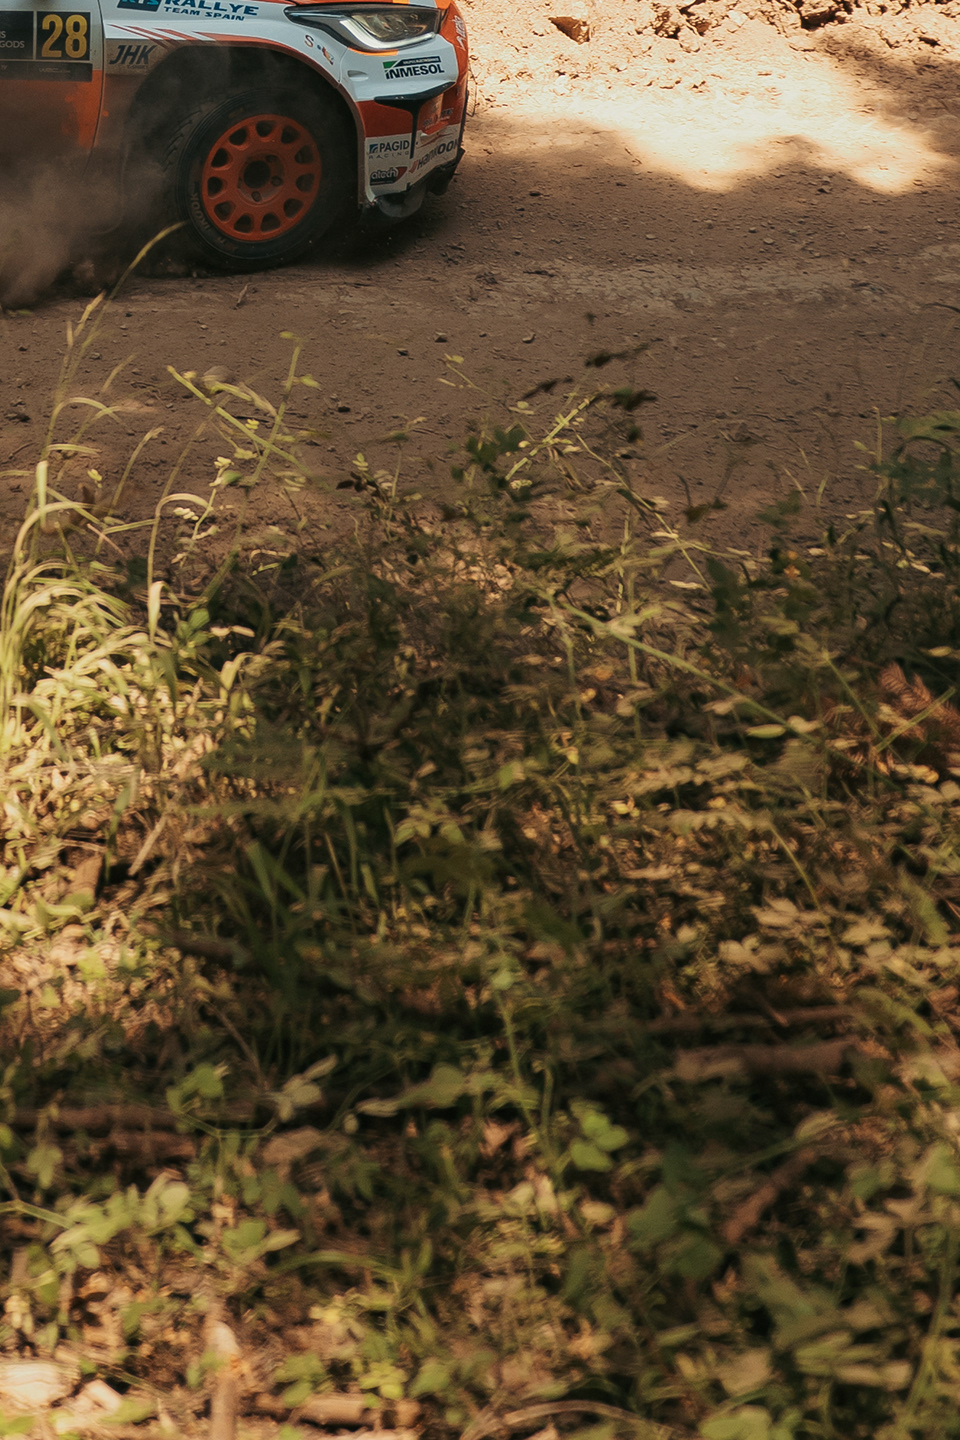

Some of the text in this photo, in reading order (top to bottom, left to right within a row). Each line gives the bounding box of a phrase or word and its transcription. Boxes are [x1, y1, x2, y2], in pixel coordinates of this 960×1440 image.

[164, 6, 245, 21] TEAM SPAIN
[41, 14, 88, 58] 28
[109, 44, 158, 65] JHK
[379, 140, 410, 153] PAGID
[369, 150, 410, 159] RACING
